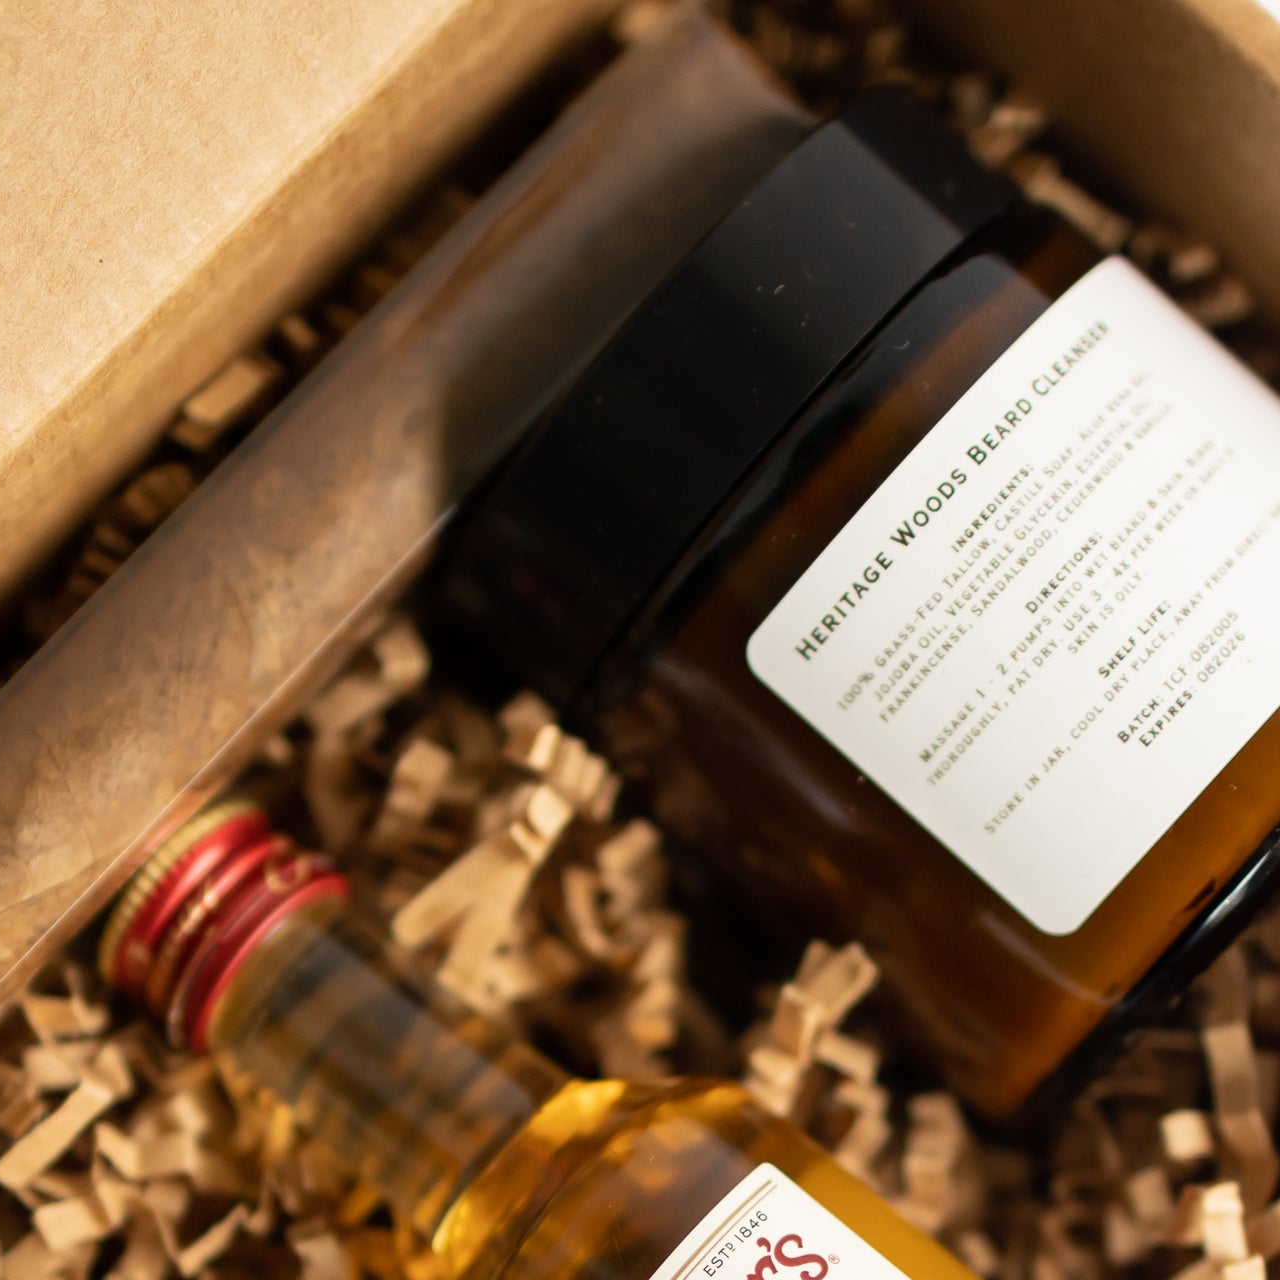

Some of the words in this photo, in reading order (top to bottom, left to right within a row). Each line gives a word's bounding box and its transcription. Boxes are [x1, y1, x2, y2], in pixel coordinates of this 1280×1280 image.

[795, 551, 893, 660] HERITAGE
[889, 468, 966, 546] WOODS
[965, 399, 1031, 465] BEARD
[1031, 321, 1107, 396] CLEANSER
[951, 467, 1029, 552] INGREDIENTS:
[837, 672, 874, 710] 100%
[874, 591, 943, 667] GRASS-FED
[941, 537, 996, 588] TALLOW,
[993, 481, 1043, 531] CASTILE
[874, 652, 919, 701] JOJOBA
[917, 622, 948, 648] OIL,
[943, 543, 1014, 616] VEGETABLE
[1013, 476, 1078, 541] GLYCERIN,
[879, 622, 973, 722] FRANKINCENSE,
[970, 527, 1057, 617] SANDALWOOD,
[918, 704, 974, 762] MASSAGE
[996, 663, 1008, 675] 2
[1009, 615, 1051, 661] PUMPS
[1052, 581, 1082, 613] INTO
[1083, 552, 1107, 578] WET
[1108, 511, 1146, 551] BEARD
[1024, 535, 1101, 614] DIRECTIONS:
[1067, 621, 1098, 653] SKIN
[1098, 603, 1114, 620] IS
[1098, 636, 1135, 678] SHELF
[1136, 601, 1170, 635] LIFE:
[926, 701, 1008, 785] THOROUGHLY,
[1006, 668, 1031, 695] PAT
[1062, 603, 1090, 631] USE
[1090, 589, 1102, 601] 3
[1129, 534, 1153, 558] PER
[983, 792, 1023, 834] STORE
[1024, 774, 1040, 790] IN
[1070, 705, 1104, 739] COOL
[1103, 672, 1128, 702] DRY
[1173, 593, 1203, 625] AWAY
[1116, 697, 1159, 743] BATCH:
[1138, 687, 1193, 747] EXPIRES:
[1196, 633, 1245, 683] 082026
[733, 1210, 767, 1243] 1846
